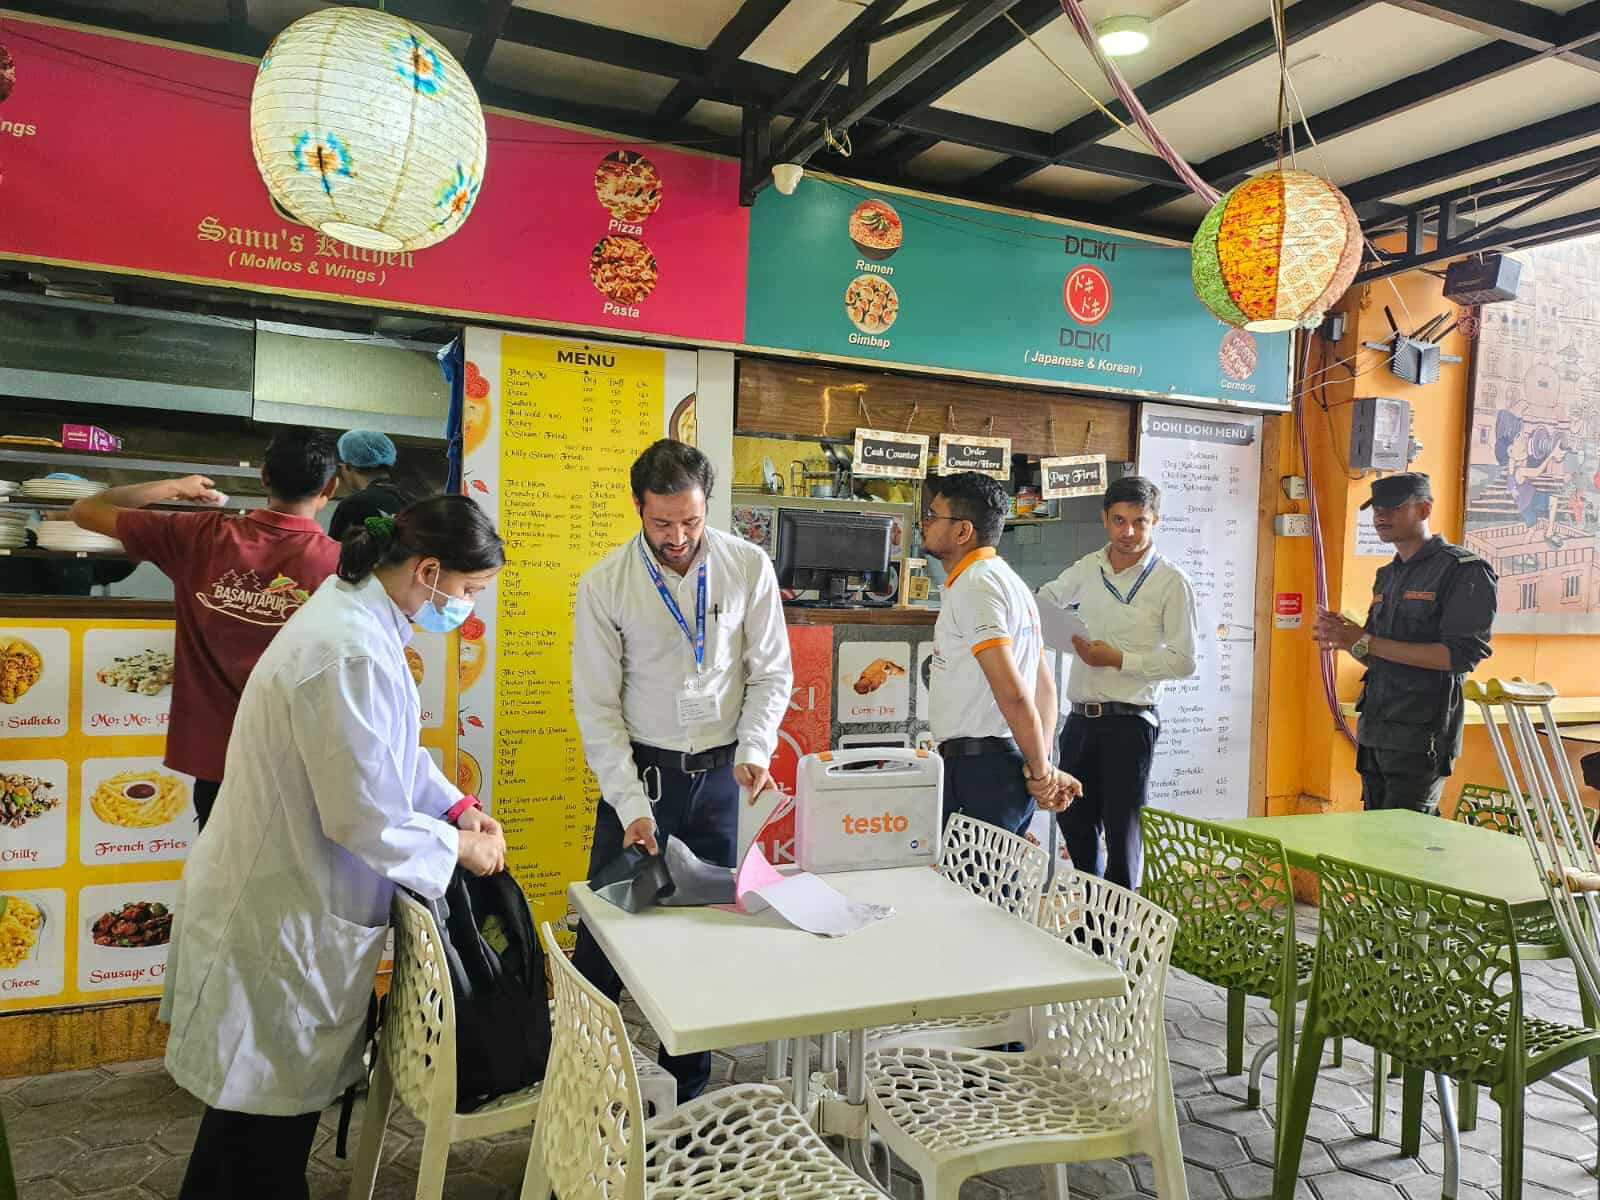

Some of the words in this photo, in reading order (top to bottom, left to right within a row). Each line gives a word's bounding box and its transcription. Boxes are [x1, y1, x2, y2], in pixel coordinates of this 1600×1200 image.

[0, 118, 37, 137] ngs
[197, 216, 304, 254] Sanu's
[608, 219, 643, 235] Pizza
[1065, 234, 1116, 263] DOKI
[239, 254, 302, 273] MoMos
[308, 260, 319, 274] &
[325, 263, 376, 283] Wings
[856, 259, 894, 276] Ramen
[602, 302, 640, 318] Pasta
[848, 333, 891, 350] Gimbap
[1059, 327, 1111, 354] DOKI
[557, 350, 616, 368] MENU
[1031, 351, 1084, 370] Japanese
[1087, 358, 1096, 368] &
[1098, 358, 1136, 375] Korean
[1220, 379, 1256, 393] Corndog
[1152, 421, 1182, 433] DOKI
[1184, 423, 1213, 435] DOKI
[1215, 427, 1247, 439] MENU
[864, 446, 884, 458] Cash
[886, 448, 919, 461] Counter
[963, 446, 986, 457] Order
[1050, 471, 1070, 486] Pay
[1072, 469, 1098, 483] First
[214, 584, 287, 612] BASANTAPUR
[7, 714, 61, 729] Sadheko
[842, 812, 909, 834] testo
[1, 849, 38, 862] Chilly
[95, 840, 144, 856] French
[149, 838, 187, 853] Fries
[2, 977, 41, 991] Cheese
[90, 967, 146, 984] Sausage
